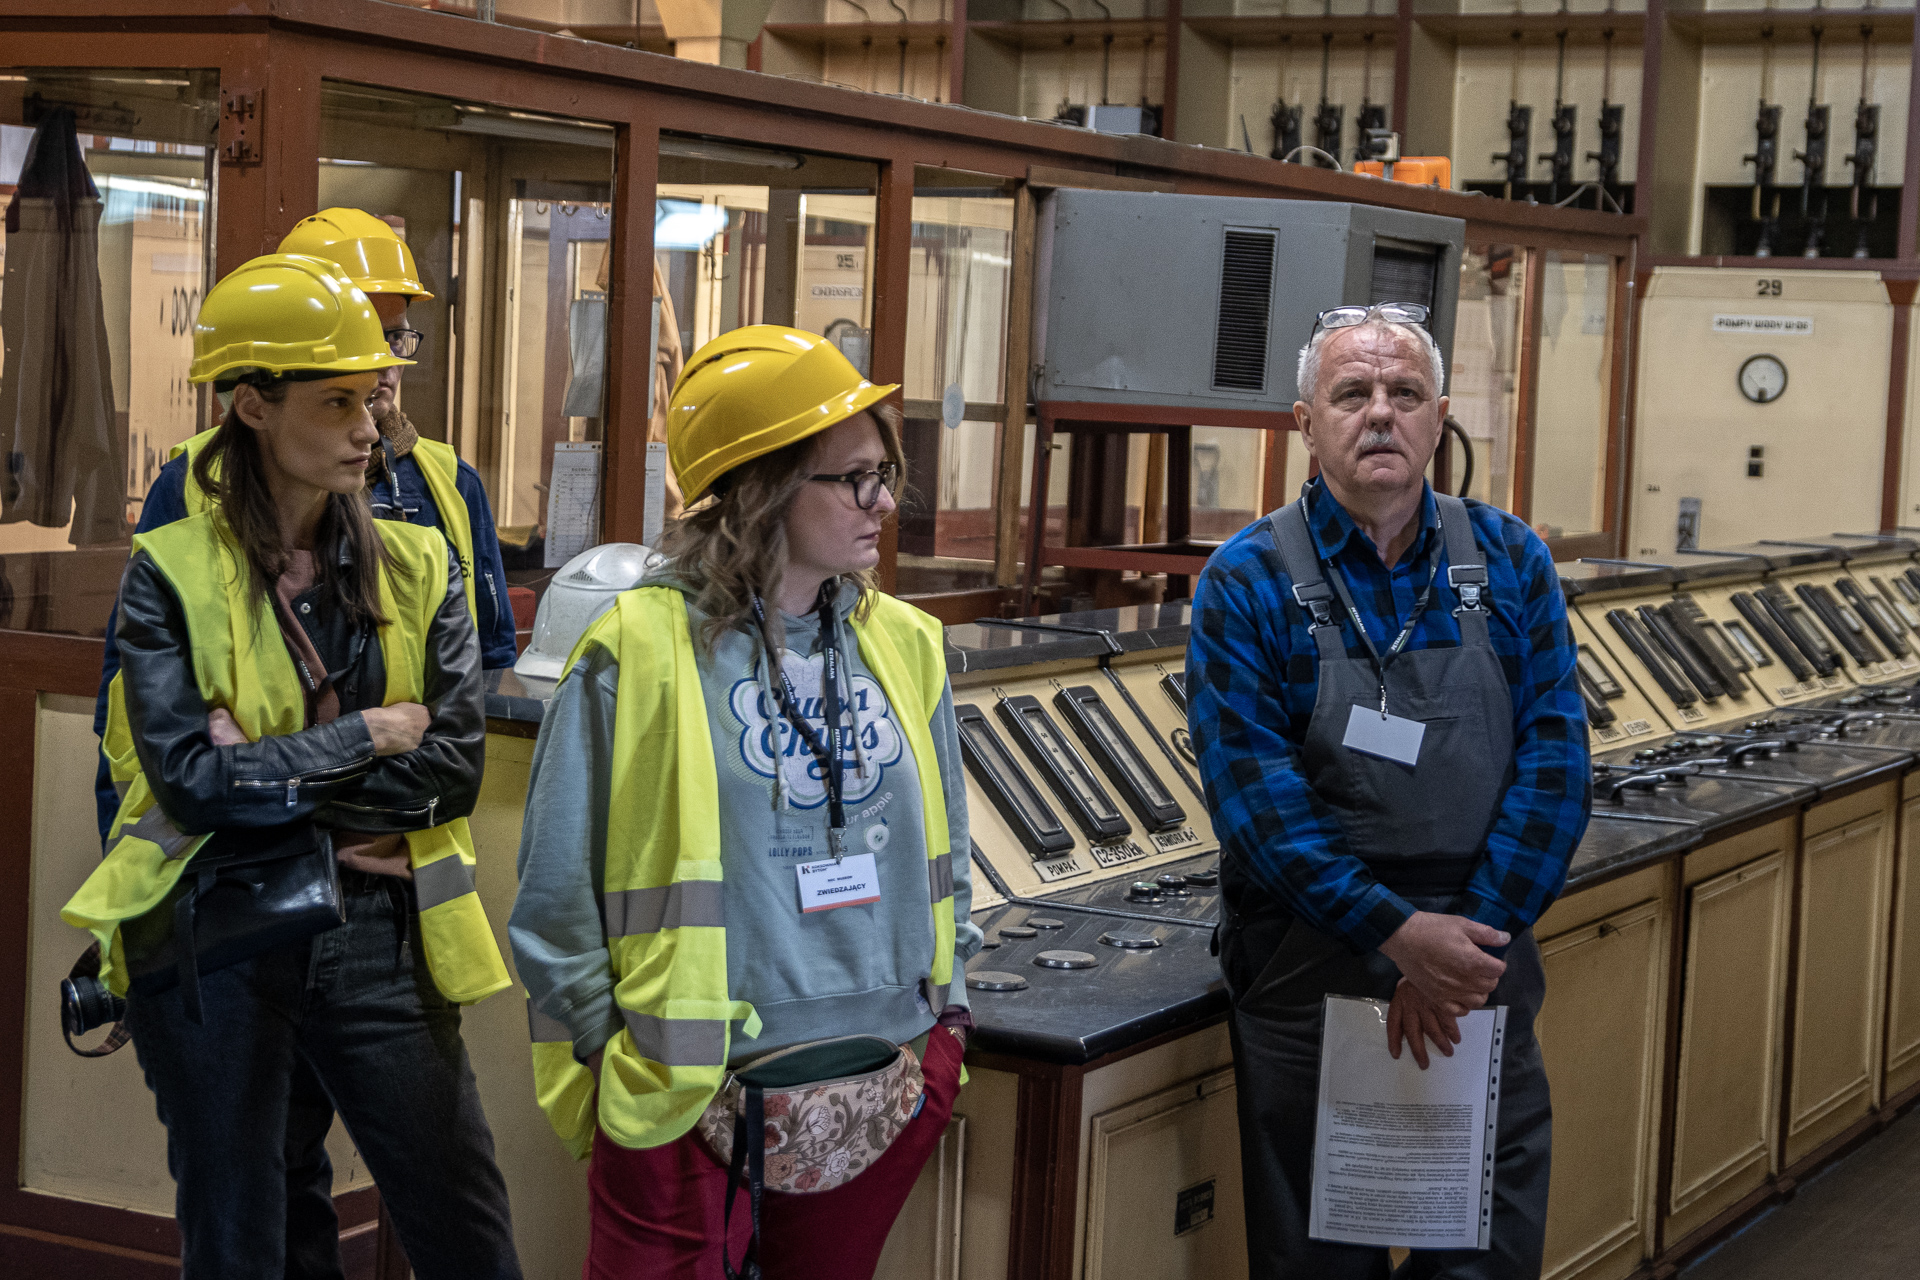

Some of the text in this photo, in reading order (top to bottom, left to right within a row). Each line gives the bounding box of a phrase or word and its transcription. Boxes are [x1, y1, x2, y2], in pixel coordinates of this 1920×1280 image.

[1757, 279, 1782, 296] 29
[828, 647, 836, 679] PETRALANA
[780, 671, 796, 704] PETRALANA
[757, 686, 870, 725] Cua
[834, 728, 842, 760] PETRALANA
[845, 791, 894, 825] ur apple
[768, 847, 790, 857] LOLLY
[791, 846, 813, 857] POPS
[1155, 832, 1186, 848] KOMORA
[1046, 859, 1081, 877] POMPA 1
[816, 883, 867, 896] ZWIEDZAJĄCY
